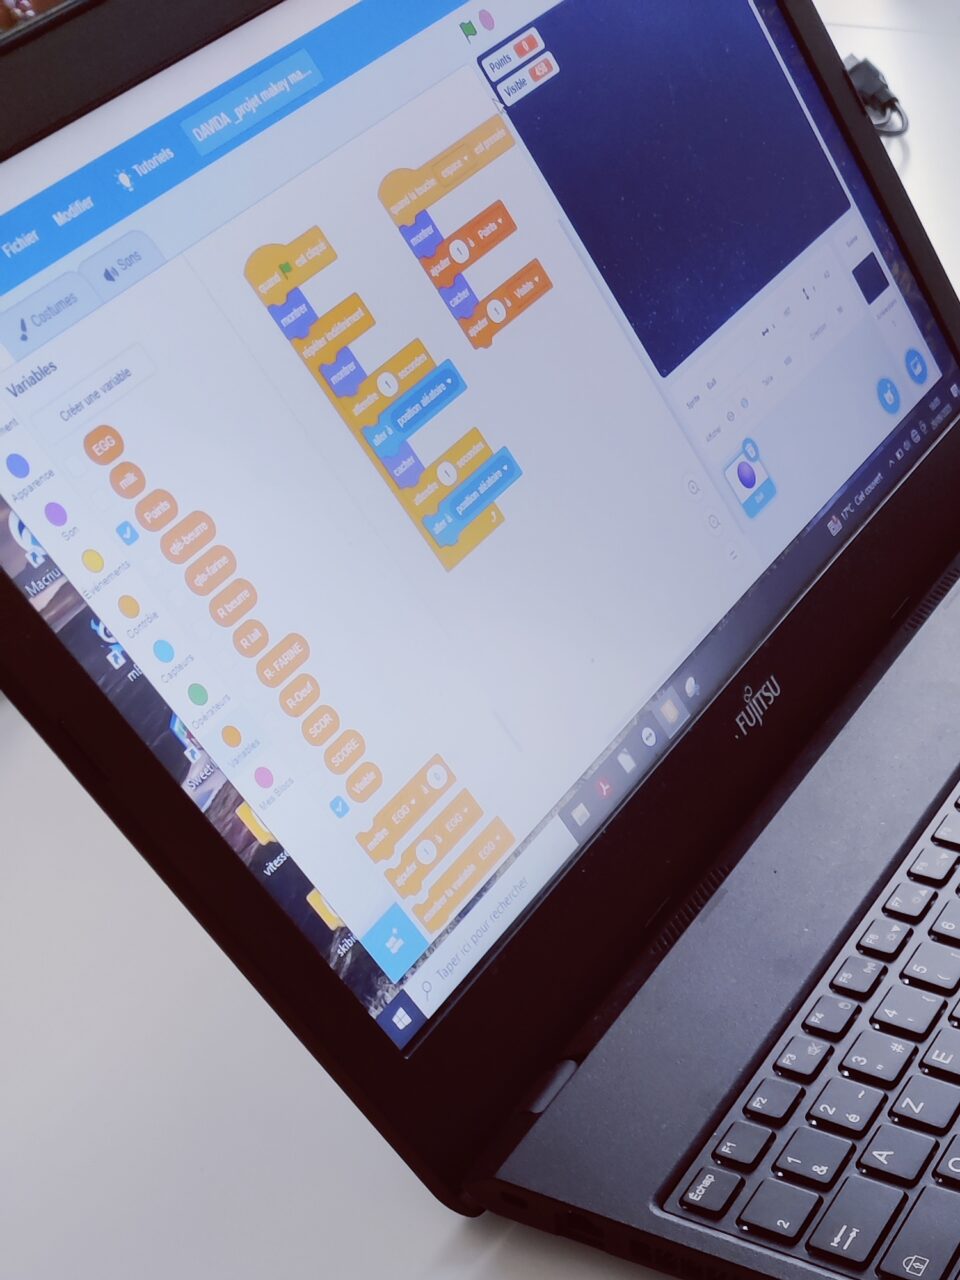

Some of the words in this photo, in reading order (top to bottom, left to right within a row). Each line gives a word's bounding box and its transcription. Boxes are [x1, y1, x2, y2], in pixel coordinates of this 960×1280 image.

[489, 53, 512, 73] Points
[503, 76, 528, 97] Visible
[192, 111, 232, 142] DAVIDA
[259, 78, 290, 103] makey
[132, 148, 175, 177] Tutoriels
[52, 196, 94, 227] Modifier
[1, 229, 40, 258] Fichier
[116, 251, 142, 271] Sons
[449, 287, 470, 309] cacher
[30, 291, 78, 328] Costumes
[6, 360, 58, 398] Variables
[59, 399, 85, 423] Créer
[83, 388, 101, 406] une
[99, 367, 132, 395] variable
[397, 401, 422, 428] position
[91, 435, 117, 457] EGG
[393, 455, 416, 477] cacher
[11, 468, 56, 502] Apparence
[143, 499, 171, 523] Points
[455, 488, 480, 516] position
[61, 526, 79, 542] Son
[272, 642, 304, 672] FARINE
[735, 674, 782, 736] FUJITSU
[331, 738, 360, 767] SCORE
[436, 953, 462, 981] Taper
[460, 942, 474, 956] ici
[470, 921, 491, 947] pour
[489, 876, 529, 922] rechercher
[912, 963, 928, 975] 5
[811, 1011, 824, 1024] F4
[883, 1007, 898, 1019] 4
[782, 1053, 797, 1066] F3
[851, 1055, 868, 1066] 3
[932, 1049, 955, 1065] E
[752, 1096, 768, 1110] F2
[819, 1103, 836, 1115] 2
[901, 1097, 925, 1114] Z
[721, 1141, 737, 1155] F1
[871, 1149, 895, 1165] A
